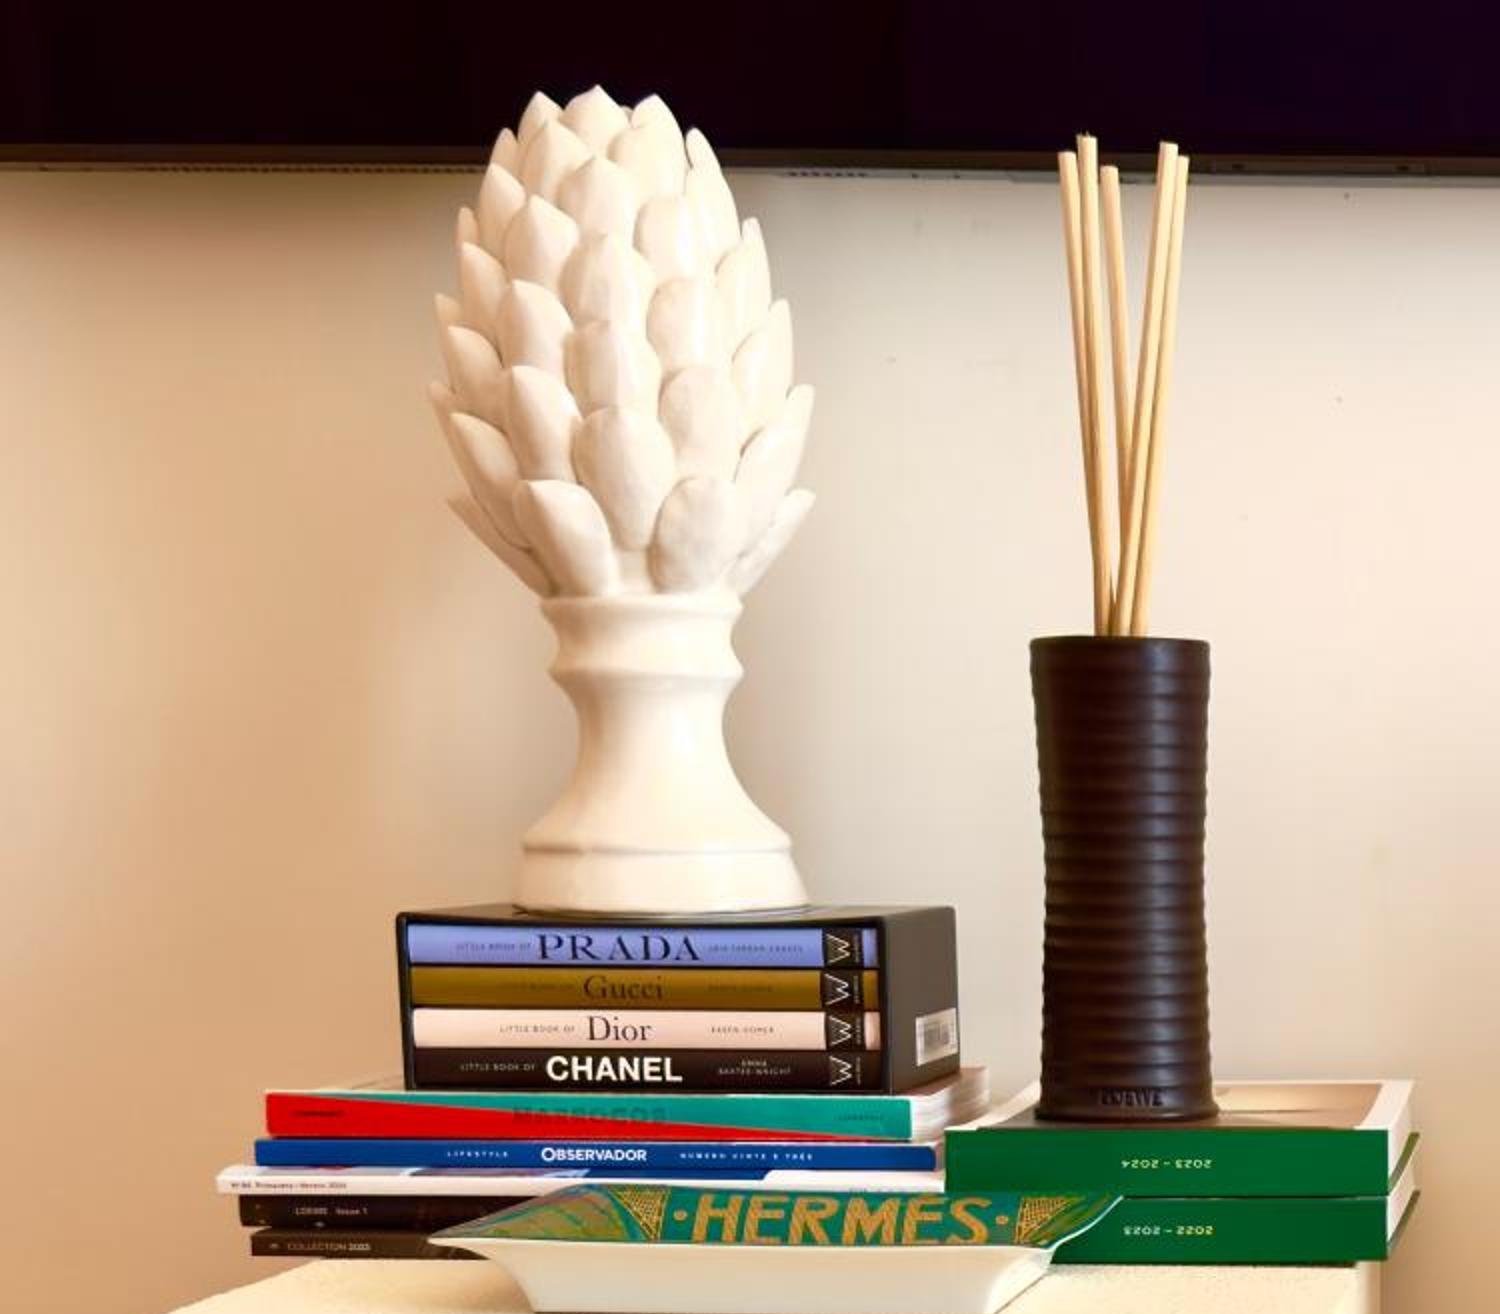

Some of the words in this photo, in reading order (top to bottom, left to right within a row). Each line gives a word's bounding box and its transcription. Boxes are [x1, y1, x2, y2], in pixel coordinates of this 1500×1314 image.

[538, 933, 701, 961] PRADA
[583, 975, 665, 1001] Gucci
[587, 1015, 652, 1041] Dior
[546, 1055, 683, 1083] CHANEL
[541, 1147, 647, 1162] OBSERVADOR
[1121, 1159, 1159, 1169] 2024
[1175, 1159, 1213, 1169] 2023
[1176, 1225, 1214, 1236] 2022
